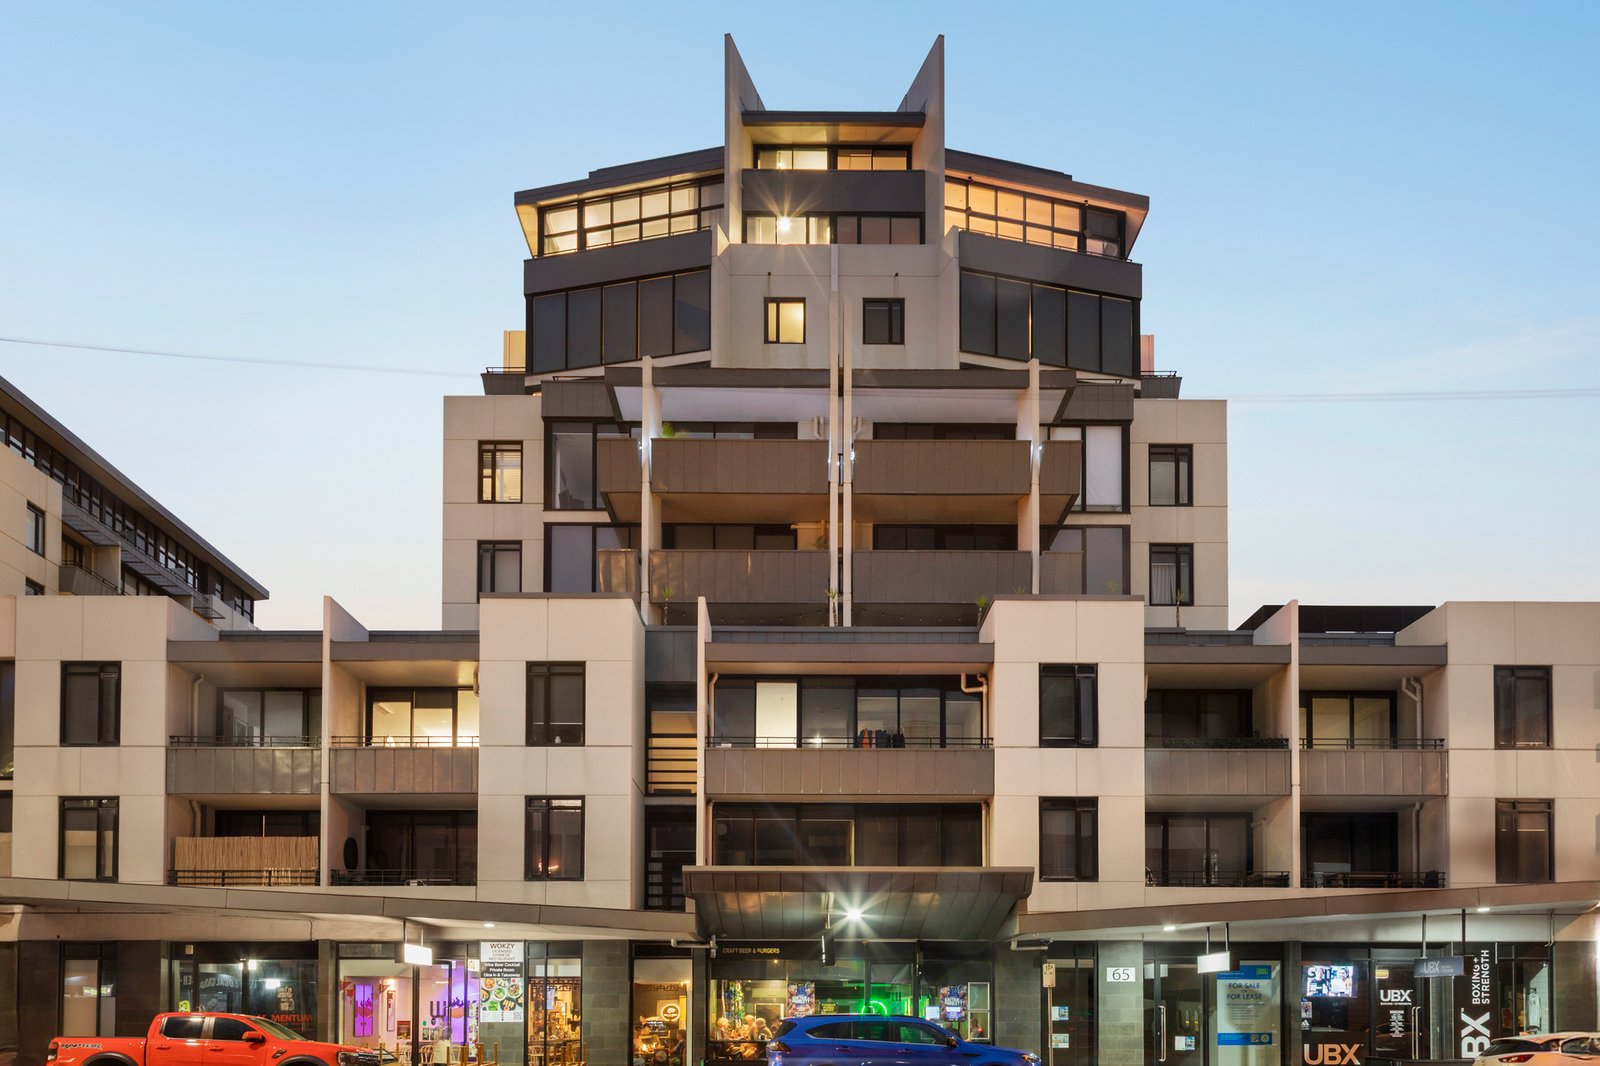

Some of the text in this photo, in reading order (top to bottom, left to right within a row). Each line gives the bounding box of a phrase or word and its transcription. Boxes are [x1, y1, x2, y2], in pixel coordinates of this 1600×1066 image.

[1423, 960, 1440, 974] UBX
[1112, 968, 1130, 981] 65
[1481, 949, 1490, 1005] STRENGTH
[1380, 989, 1411, 1002] UBX
[1303, 1043, 1361, 1065] UBX
